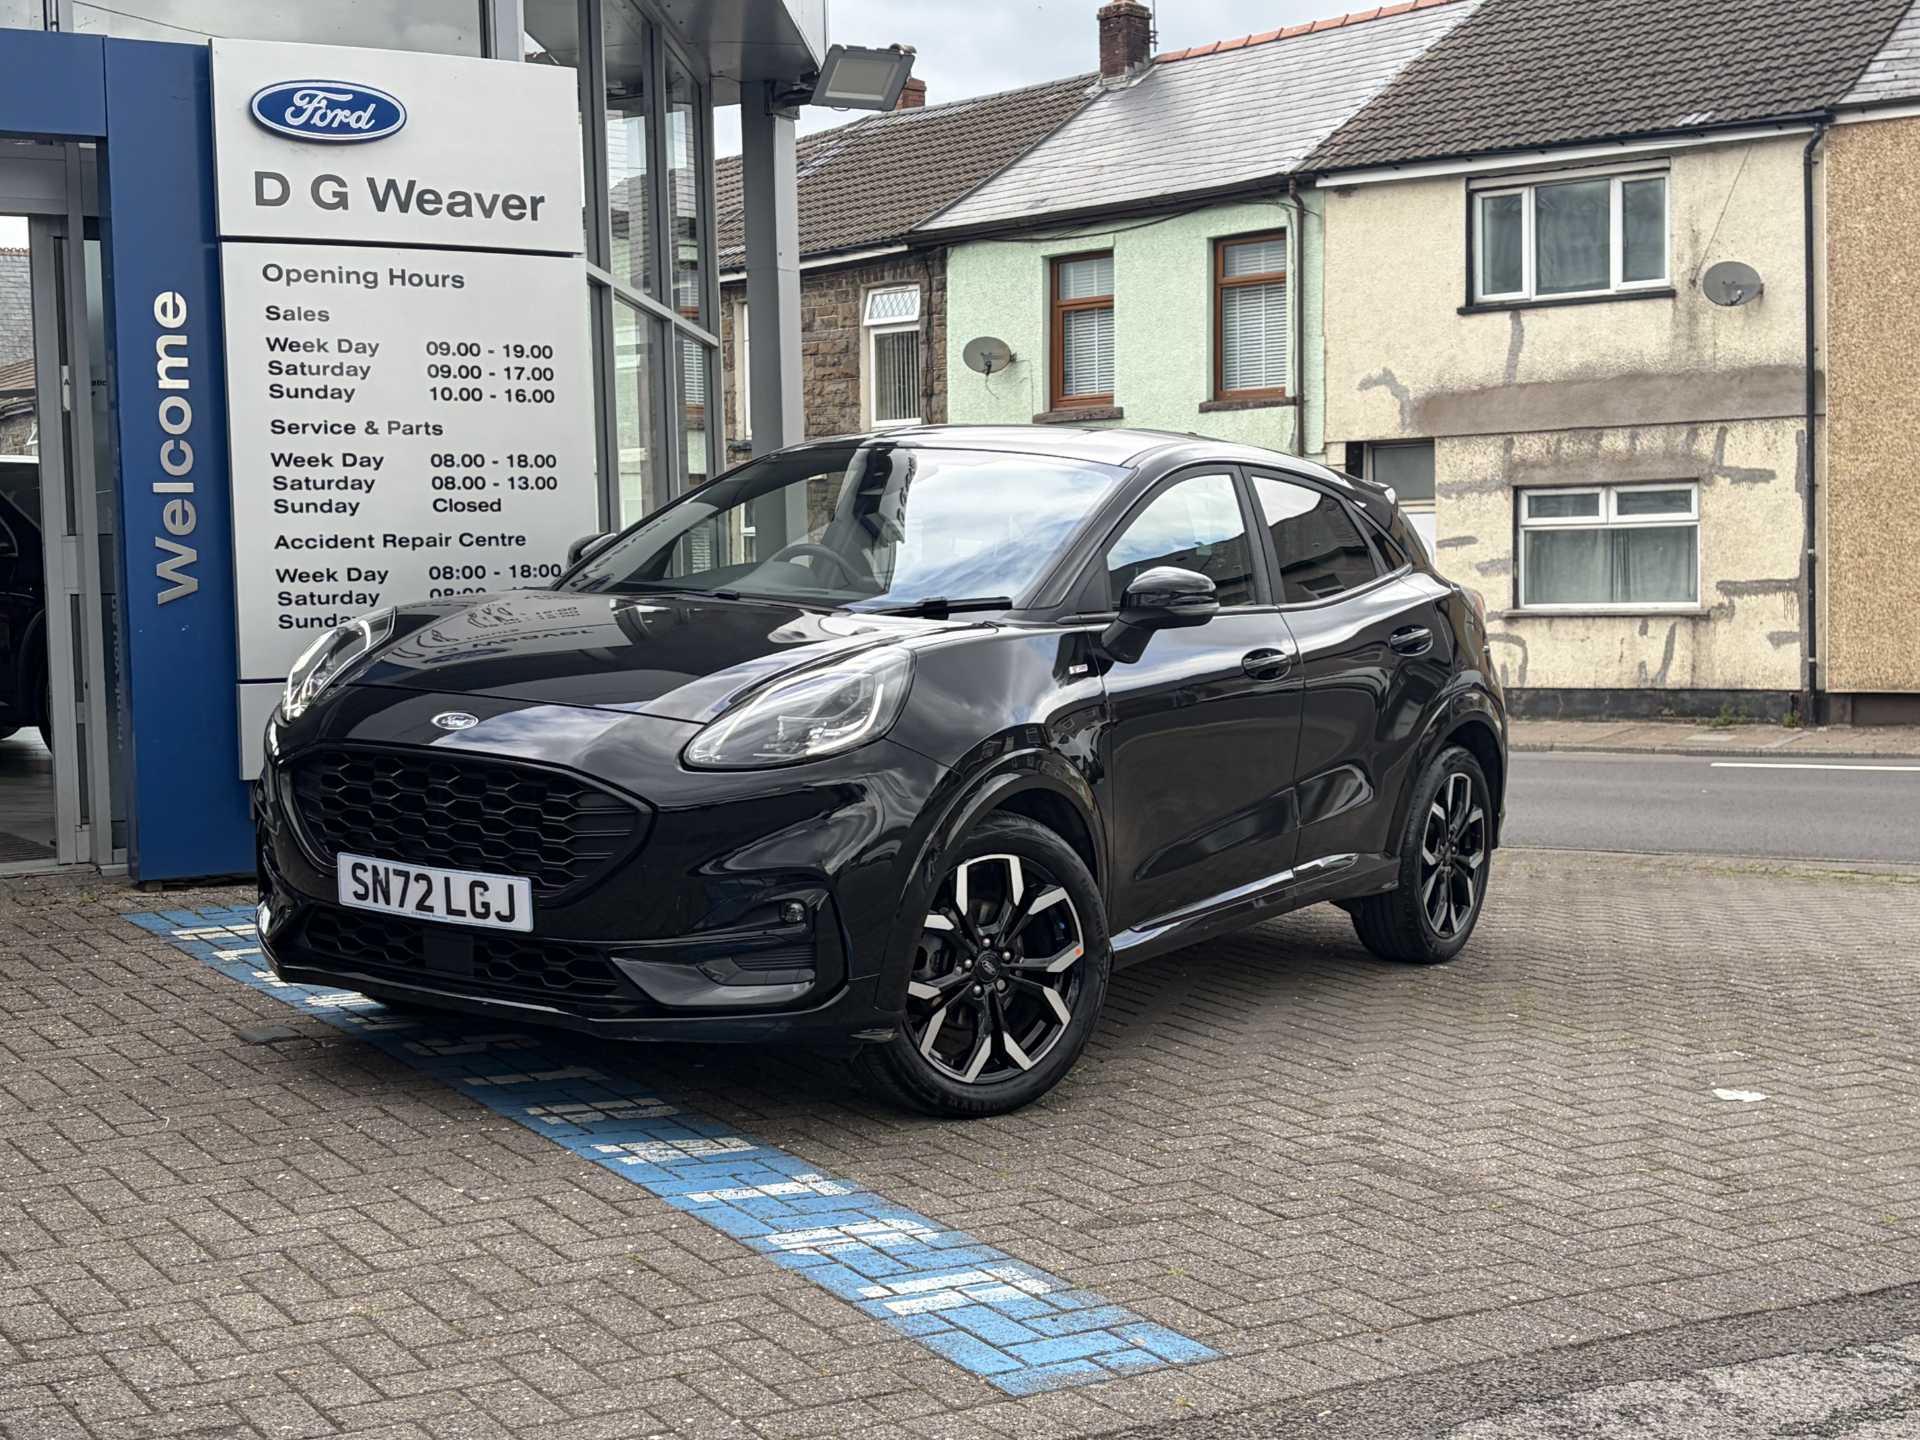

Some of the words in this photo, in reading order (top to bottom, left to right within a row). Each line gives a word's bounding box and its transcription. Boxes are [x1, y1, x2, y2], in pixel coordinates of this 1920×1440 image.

[285, 89, 376, 130] Ford
[254, 170, 291, 207] D
[310, 173, 349, 210] G
[366, 176, 545, 221] Weaver
[262, 262, 379, 289] Opening
[388, 267, 465, 289] Hours
[265, 304, 330, 323] Sales
[265, 336, 329, 354] Week
[337, 338, 380, 358] Day
[425, 340, 482, 357] 09.00
[502, 343, 554, 360] 19.00
[267, 359, 372, 381] Saturday
[426, 363, 483, 380] 09.00
[503, 366, 555, 383] 17.00
[268, 383, 356, 404] Sunday
[429, 386, 484, 403] 10.00
[504, 388, 556, 405] 16.00
[270, 418, 357, 436] Service
[364, 420, 381, 436] &
[387, 420, 444, 437] Parts
[152, 291, 198, 606] Welcome
[270, 452, 334, 469] Week
[341, 452, 385, 472] Day
[430, 453, 486, 469] 08.00
[506, 453, 557, 469] 18.00
[272, 475, 376, 494] Saturday
[431, 475, 487, 491] 08.00
[507, 475, 558, 491] 13.00
[273, 498, 361, 517] Sunday
[432, 497, 502, 514] Closed
[273, 533, 376, 550] Accident
[382, 532, 453, 552] Repair
[458, 532, 527, 549] Centre
[275, 568, 339, 584] Week
[346, 567, 389, 585] Day
[428, 564, 487, 580] 08:00
[508, 563, 562, 579] 18:00
[277, 590, 381, 608] Saturday
[351, 862, 435, 913] SN72
[444, 876, 516, 923] LGJ
